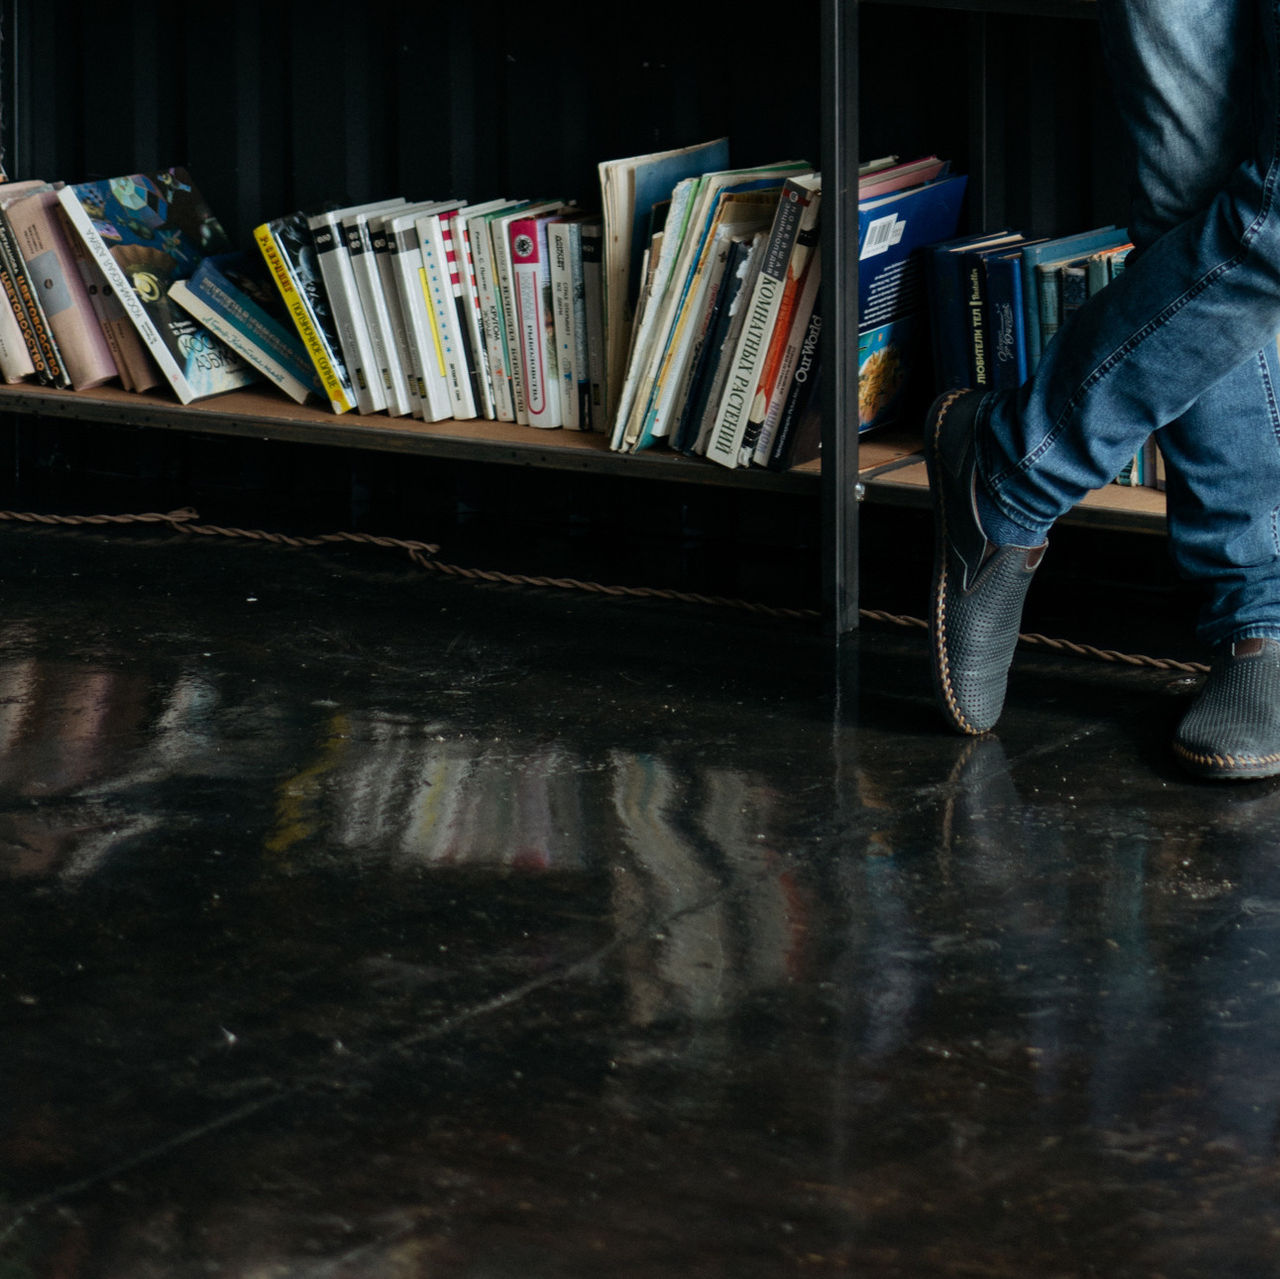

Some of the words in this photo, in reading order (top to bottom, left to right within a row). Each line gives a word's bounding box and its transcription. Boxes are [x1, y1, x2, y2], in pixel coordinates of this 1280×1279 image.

[766, 202, 791, 275] ЭНЦИКЛОПЕДИЯ
[773, 206, 798, 277] НОВЕЙШАЯ
[291, 301, 321, 356] ПОЛУНОЧНОЕ
[317, 356, 338, 389] СОЛНЦЕ
[490, 305, 500, 341] КРУГОМ
[738, 276, 778, 375] КОМНАТНЫХ
[800, 314, 822, 356] World
[972, 308, 982, 328] ТЕЛ
[794, 357, 812, 383] Our
[976, 330, 986, 385] ЛЮБИТЕЛИ
[714, 377, 750, 455] РАСТЕНИЙ
